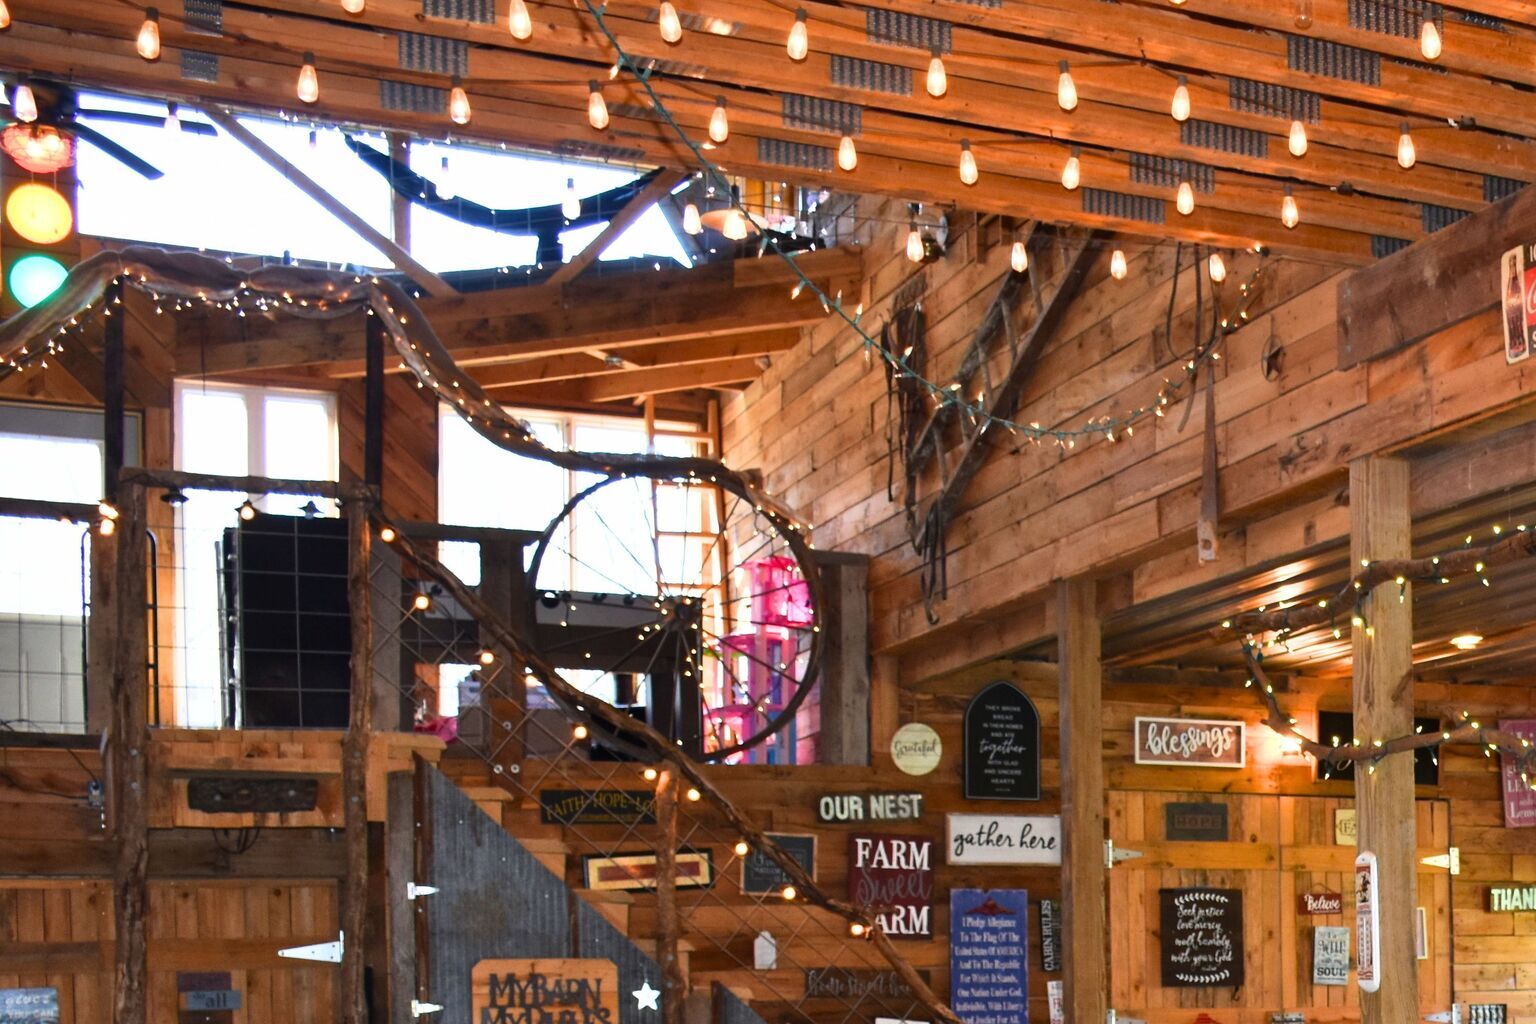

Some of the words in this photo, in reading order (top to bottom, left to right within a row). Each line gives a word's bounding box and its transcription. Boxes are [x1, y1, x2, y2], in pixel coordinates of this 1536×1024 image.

[1145, 723, 1234, 758] blessings
[594, 793, 628, 808] HOPE
[820, 796, 864, 821] OUR
[870, 794, 922, 819] NEST
[1175, 815, 1221, 829] HOPE
[953, 821, 1014, 857] gather
[1019, 823, 1056, 850] here
[855, 838, 931, 871] FARM
[856, 862, 933, 906] Sweet
[1304, 895, 1340, 911] Believe
[967, 917, 985, 929] Pledge
[987, 918, 1016, 928] Allegiance
[1041, 900, 1052, 935] RULES
[960, 933, 969, 942] To
[970, 933, 981, 942] The
[983, 933, 997, 944] Flag
[1009, 933, 1020, 942] The
[1042, 938, 1053, 971] CABIN
[959, 960, 971, 969] And
[972, 960, 981, 969] To
[982, 960, 993, 969] The
[994, 959, 1020, 970] Republic
[1317, 967, 1346, 976] SOUL
[960, 974, 970, 983] For
[205, 992, 226, 1008] all
[957, 988, 969, 997] One
[971, 988, 989, 997] Nation
[990, 988, 1008, 997] Under
